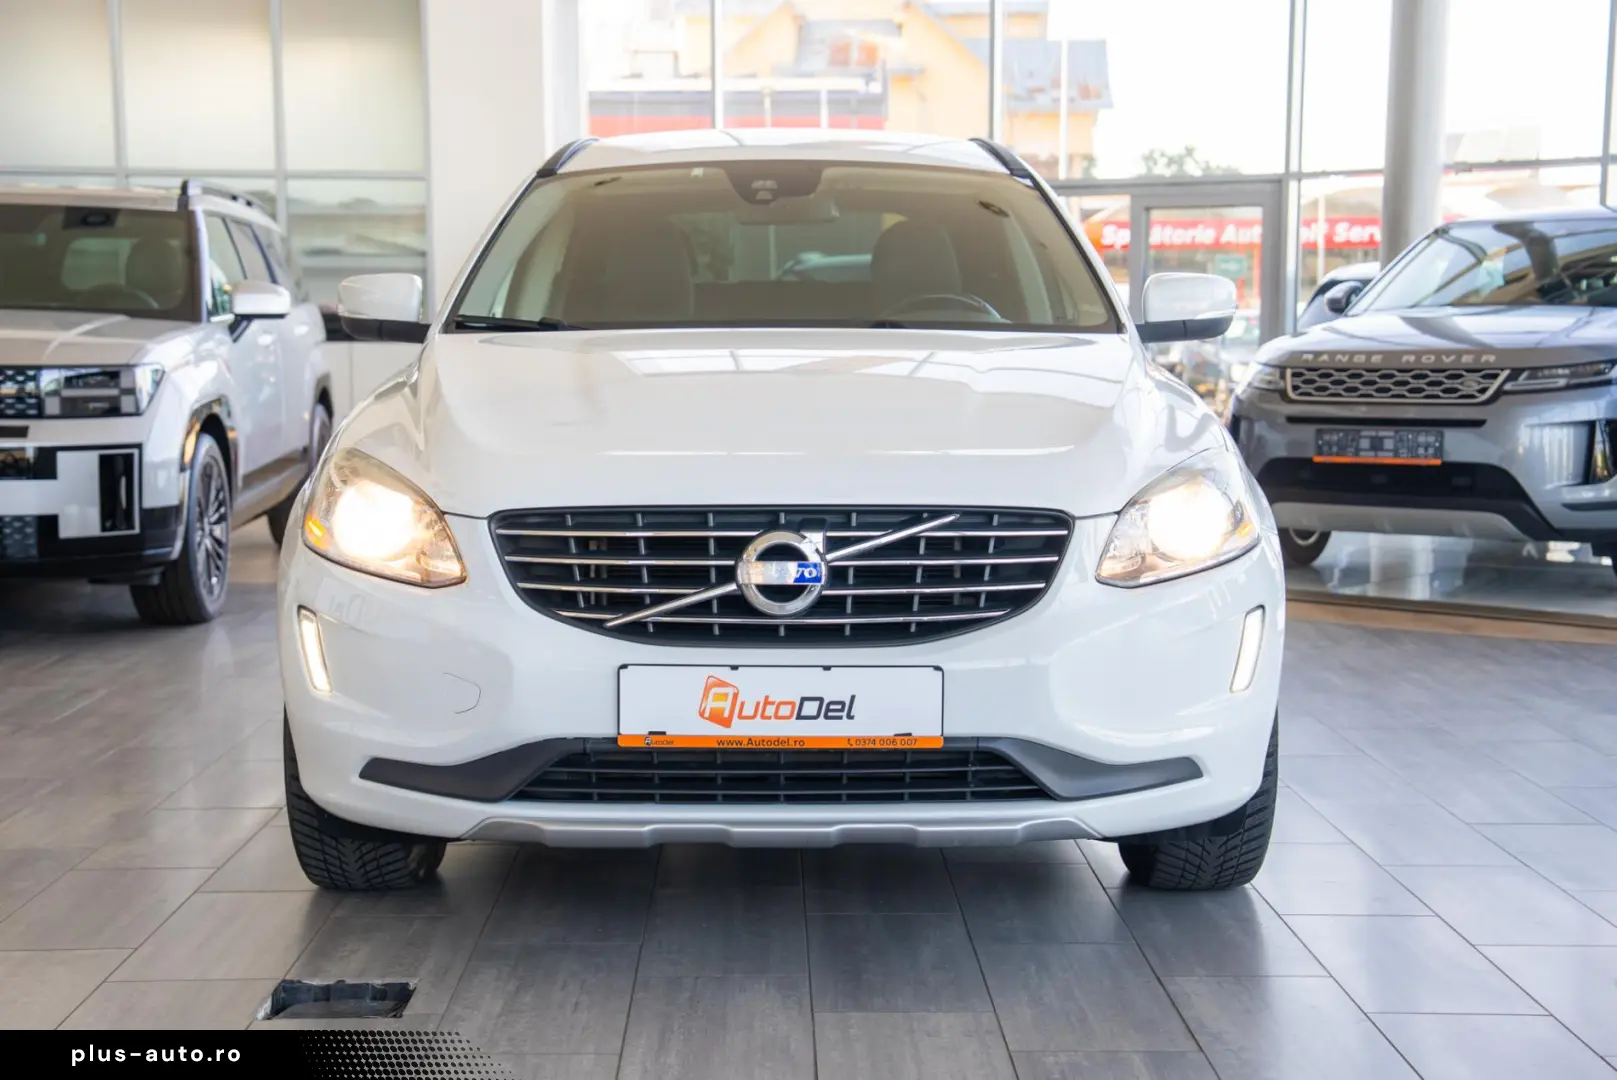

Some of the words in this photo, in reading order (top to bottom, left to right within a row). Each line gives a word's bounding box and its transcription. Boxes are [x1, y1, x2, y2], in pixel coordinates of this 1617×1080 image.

[1219, 223, 1263, 245] Aut
[1333, 221, 1382, 243] Serv
[1301, 353, 1384, 363] RANGE
[1401, 354, 1496, 363] ROVER
[698, 675, 856, 729] AutoDel
[716, 737, 805, 747] www.Autodel.ro
[855, 738, 876, 746] 0374
[879, 738, 897, 746] 006
[900, 738, 917, 746] 007
